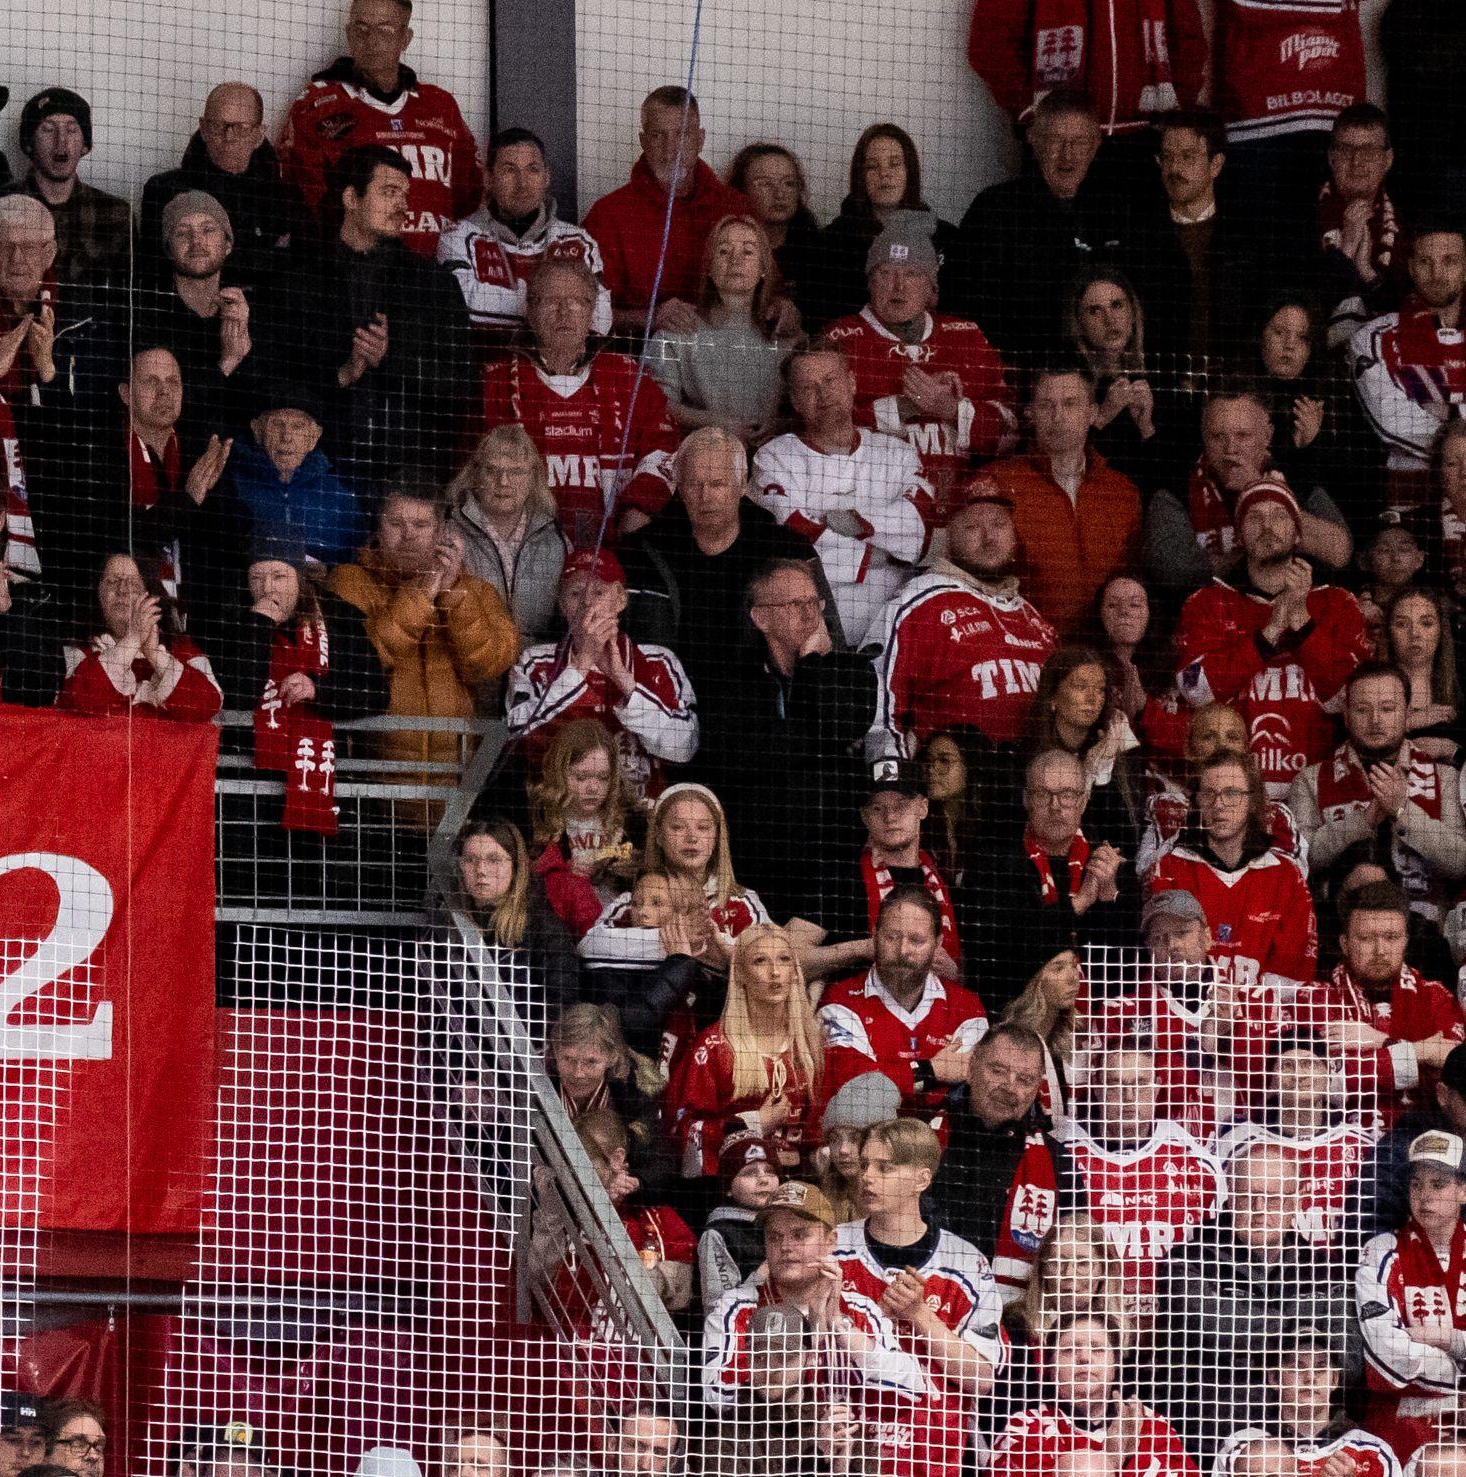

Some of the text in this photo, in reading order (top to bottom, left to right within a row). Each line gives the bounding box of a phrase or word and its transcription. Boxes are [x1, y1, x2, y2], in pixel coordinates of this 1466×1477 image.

[1266, 91, 1355, 111] BILBOLAGET
[957, 607, 981, 619] SCA
[971, 659, 1041, 701] TIM
